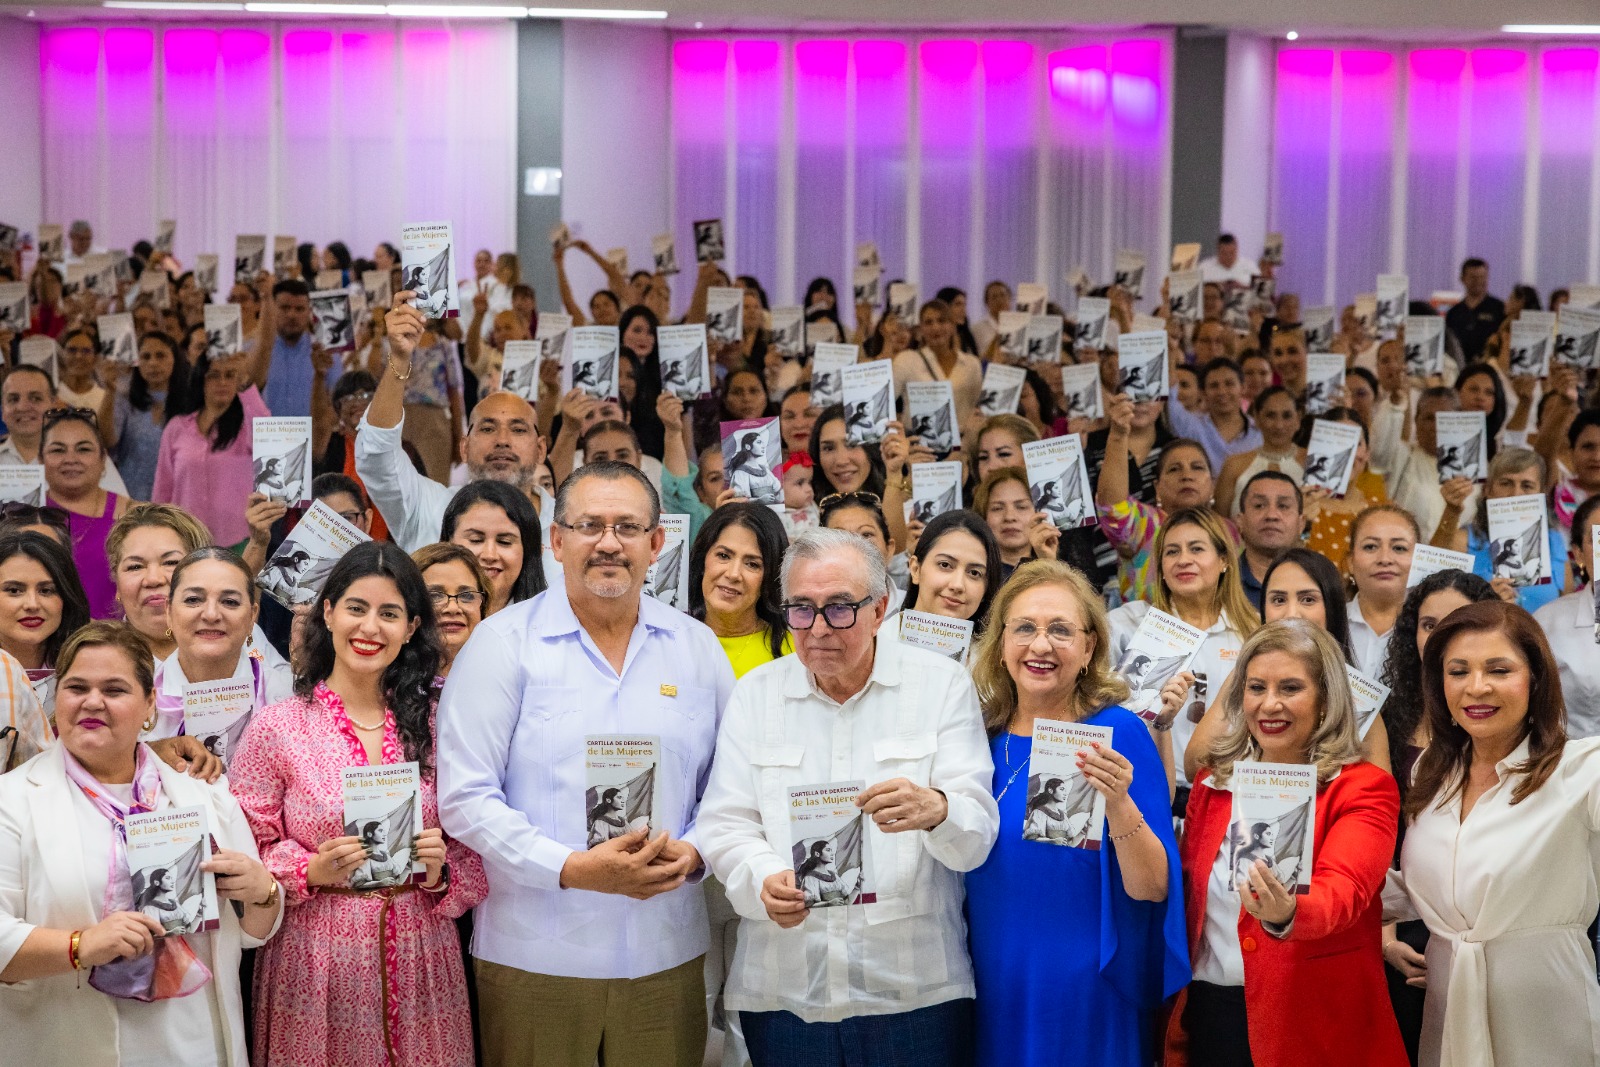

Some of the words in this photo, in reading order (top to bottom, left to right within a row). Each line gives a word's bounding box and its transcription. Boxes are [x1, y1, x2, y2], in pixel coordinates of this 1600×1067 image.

[411, 232, 421, 240] las
[422, 231, 448, 240] Mujeres
[279, 426, 307, 434] Mujeres
[1026, 444, 1046, 452] CARTILLA
[1052, 438, 1075, 447] DERECHOS
[1027, 451, 1036, 459] de
[1048, 445, 1077, 455] Mujeres
[308, 510, 318, 520] de
[318, 517, 330, 530] las
[313, 504, 335, 523] CARTILLA
[333, 521, 342, 529] DE
[340, 525, 363, 543] DERECHOS
[907, 615, 932, 626] CARTILLA
[940, 622, 968, 632] DERECHOS
[905, 622, 916, 631] de
[918, 624, 929, 633] las
[931, 627, 966, 641] Mujeres
[1155, 621, 1166, 632] las
[1166, 627, 1196, 646] Mujeres
[1176, 624, 1201, 639] DERECHOS
[186, 689, 213, 697] CARTILLA
[221, 684, 250, 692] DERECHOS
[1350, 680, 1379, 702] Mujeres
[1360, 678, 1384, 696] DERECHOS
[187, 696, 198, 706] de
[200, 695, 213, 704] las
[215, 692, 250, 702] Mujeres
[1036, 725, 1065, 734] CARTILLA
[1074, 730, 1106, 739] DERECHOS
[1036, 732, 1048, 742] de
[1050, 734, 1064, 743] las
[588, 747, 599, 756] de
[602, 747, 614, 756] las
[617, 747, 653, 757] Mujeres
[383, 768, 413, 776] DERECHOS
[1278, 770, 1310, 778] DERECHOS
[346, 779, 358, 788] de
[361, 779, 374, 788] las
[376, 776, 413, 787] Mujeres
[1253, 776, 1266, 785] las
[1270, 777, 1310, 789] Mujeres
[791, 790, 819, 798] CARTILLA
[829, 786, 860, 794] DERECHOS
[792, 799, 804, 808] de
[806, 797, 820, 806] las
[128, 818, 157, 827] CARTILLA
[167, 812, 199, 821] DERECHOS
[129, 826, 141, 837] de
[144, 825, 158, 835] las
[160, 820, 200, 832] Mujeres
